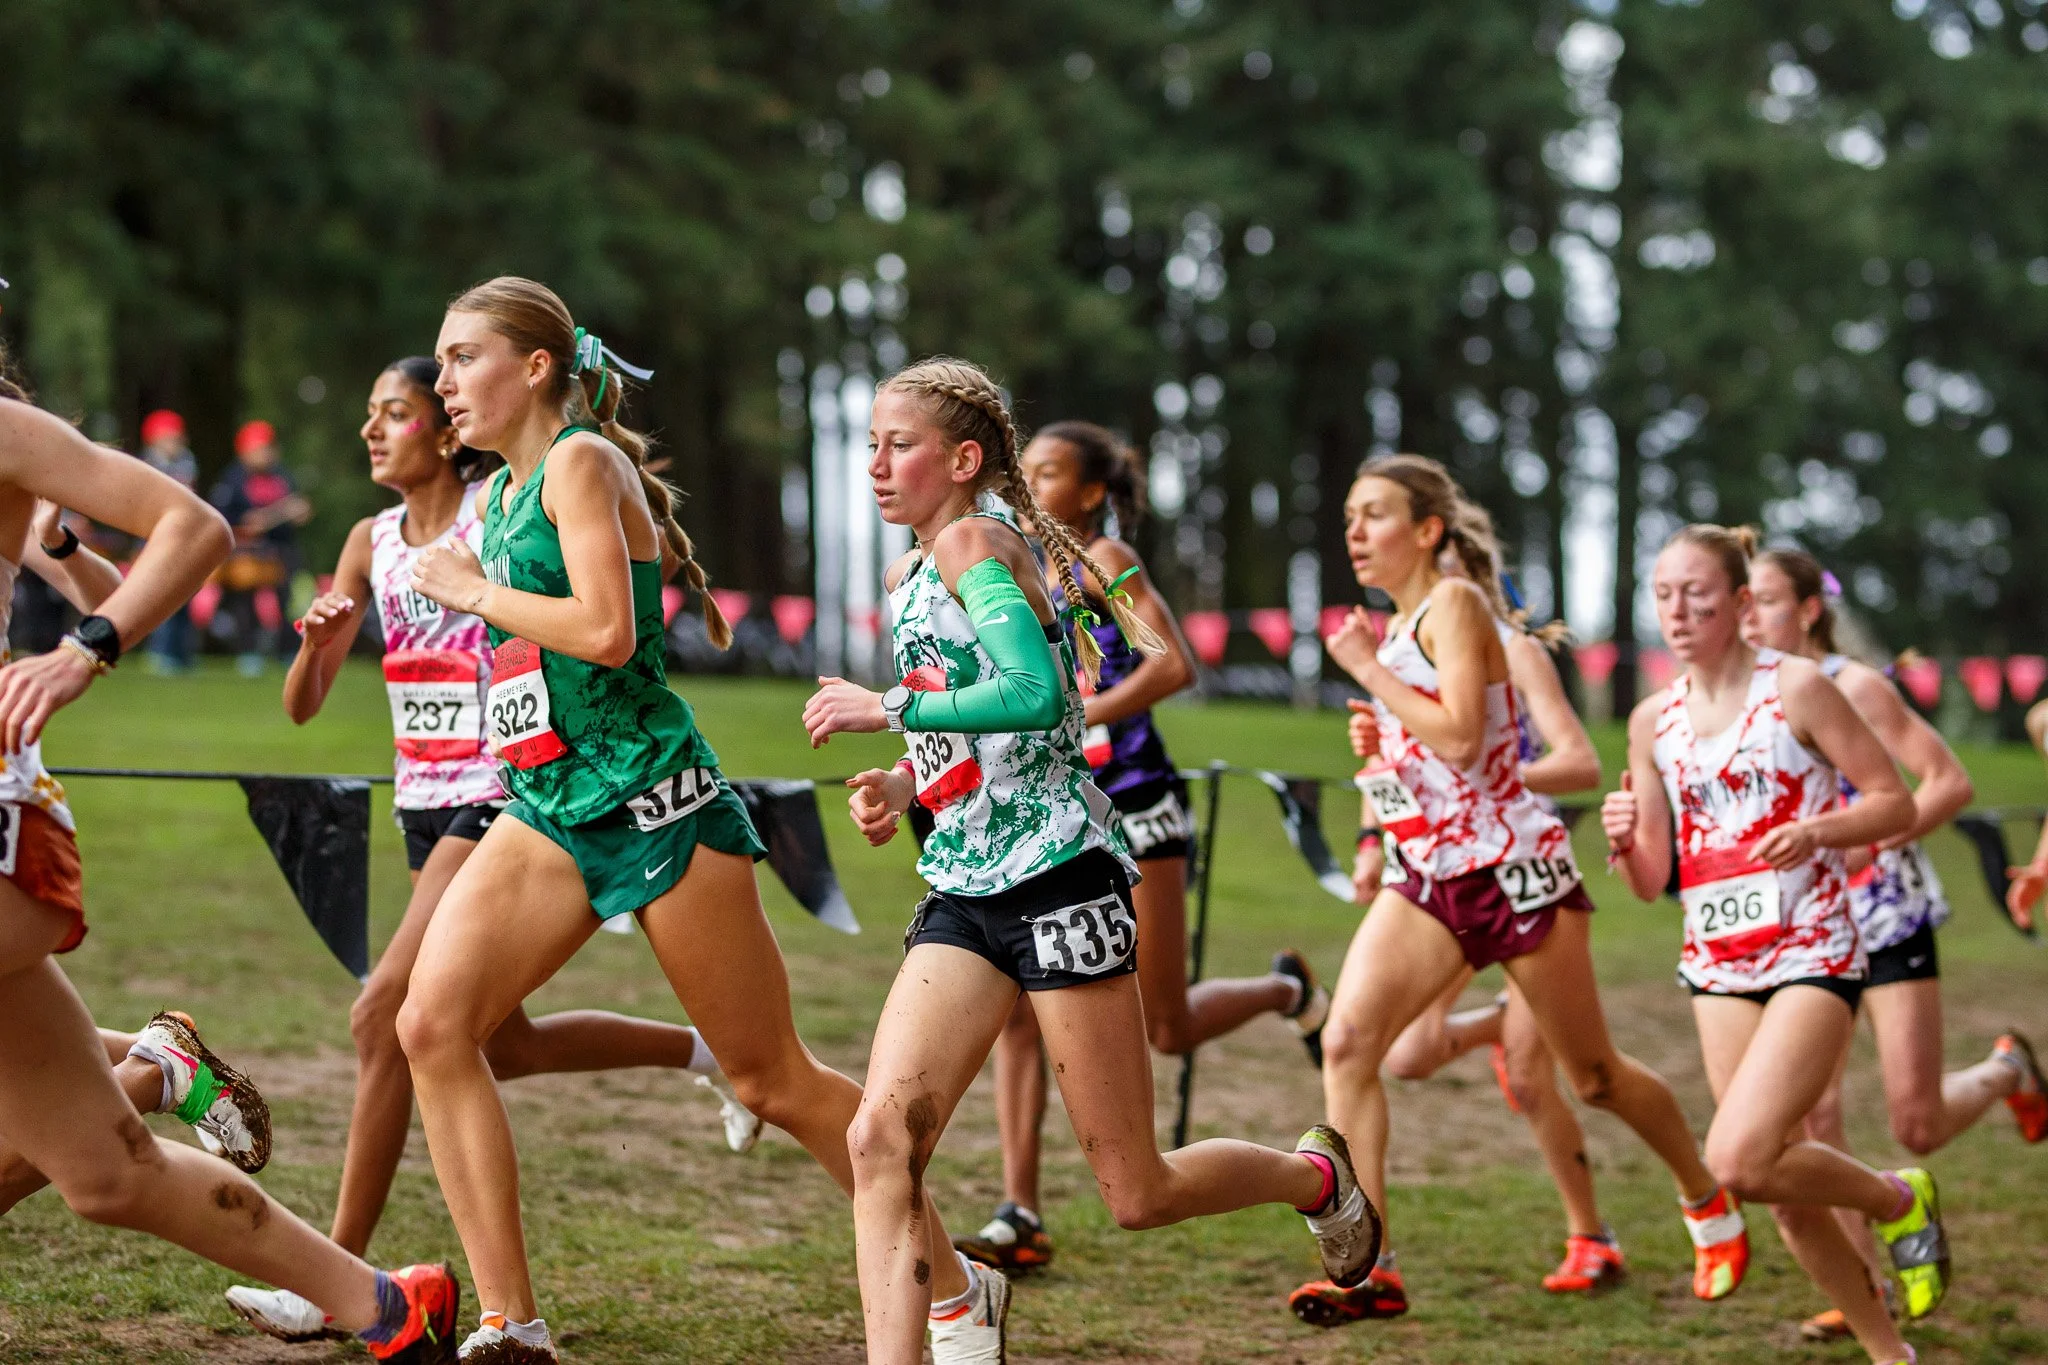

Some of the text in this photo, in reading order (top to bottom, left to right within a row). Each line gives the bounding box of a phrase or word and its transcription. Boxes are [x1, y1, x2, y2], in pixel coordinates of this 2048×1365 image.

[496, 682, 528, 699] HEEMEYER
[404, 700, 462, 731] 237
[492, 692, 539, 738] 322
[915, 732, 953, 782] 335
[1701, 891, 1762, 933] 296
[1041, 900, 1132, 973] 335
